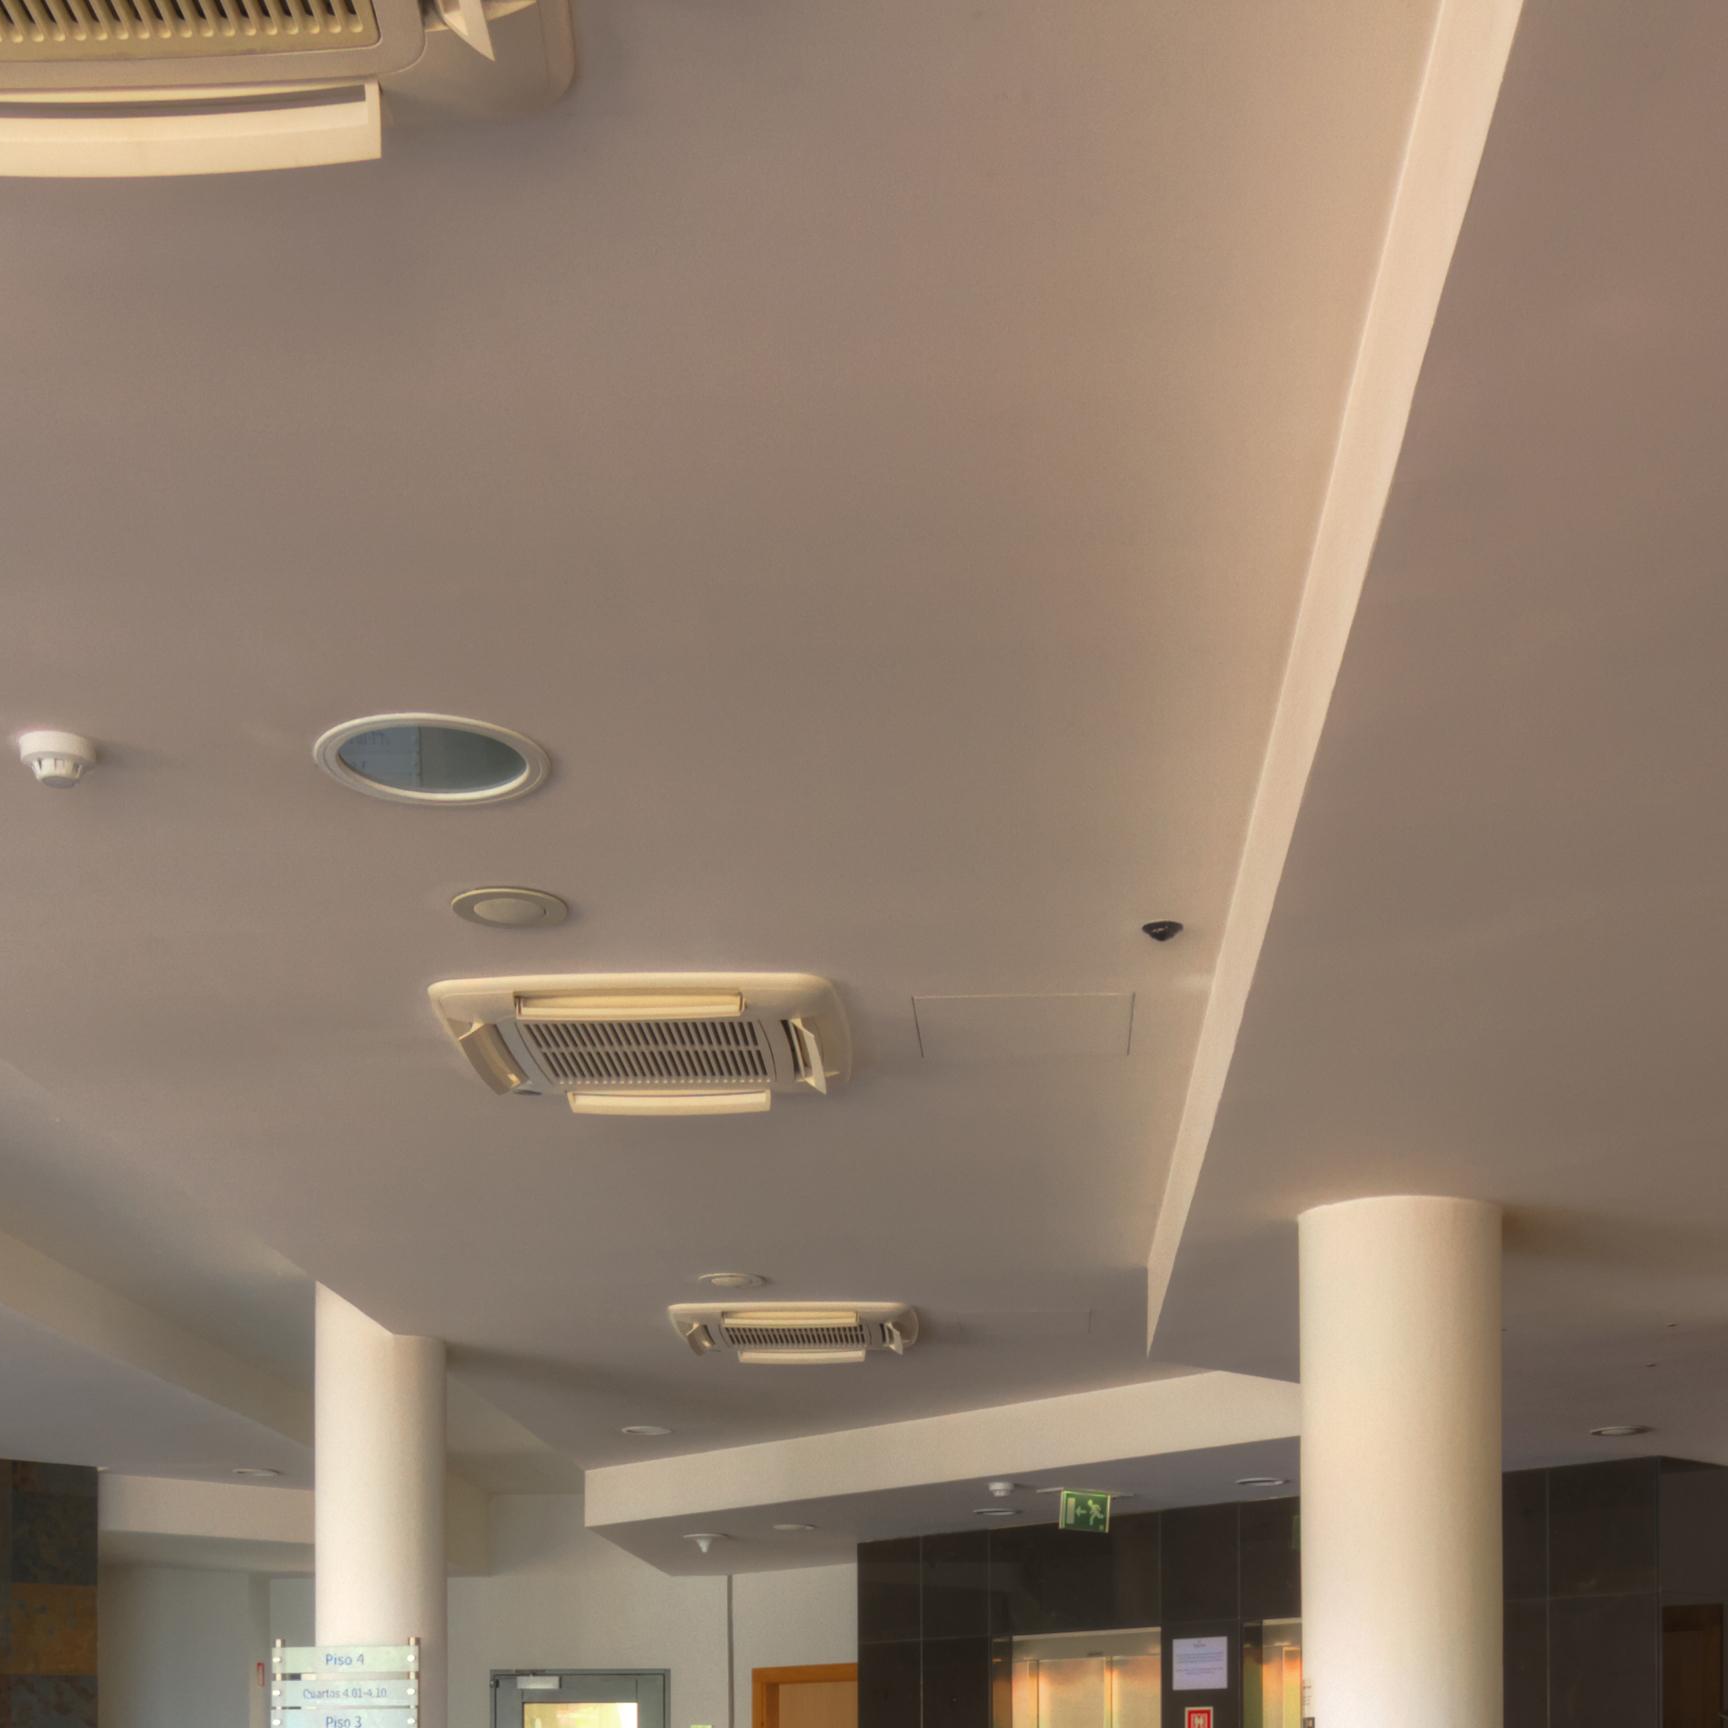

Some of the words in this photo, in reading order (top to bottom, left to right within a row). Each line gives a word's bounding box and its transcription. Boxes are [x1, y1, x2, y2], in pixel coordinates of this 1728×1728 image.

[325, 1653, 353, 1666] Piso
[357, 1653, 365, 1665] 4
[303, 1688, 341, 1699] Quartos
[325, 1716, 352, 1728] Piso
[354, 1715, 363, 1728] 3
